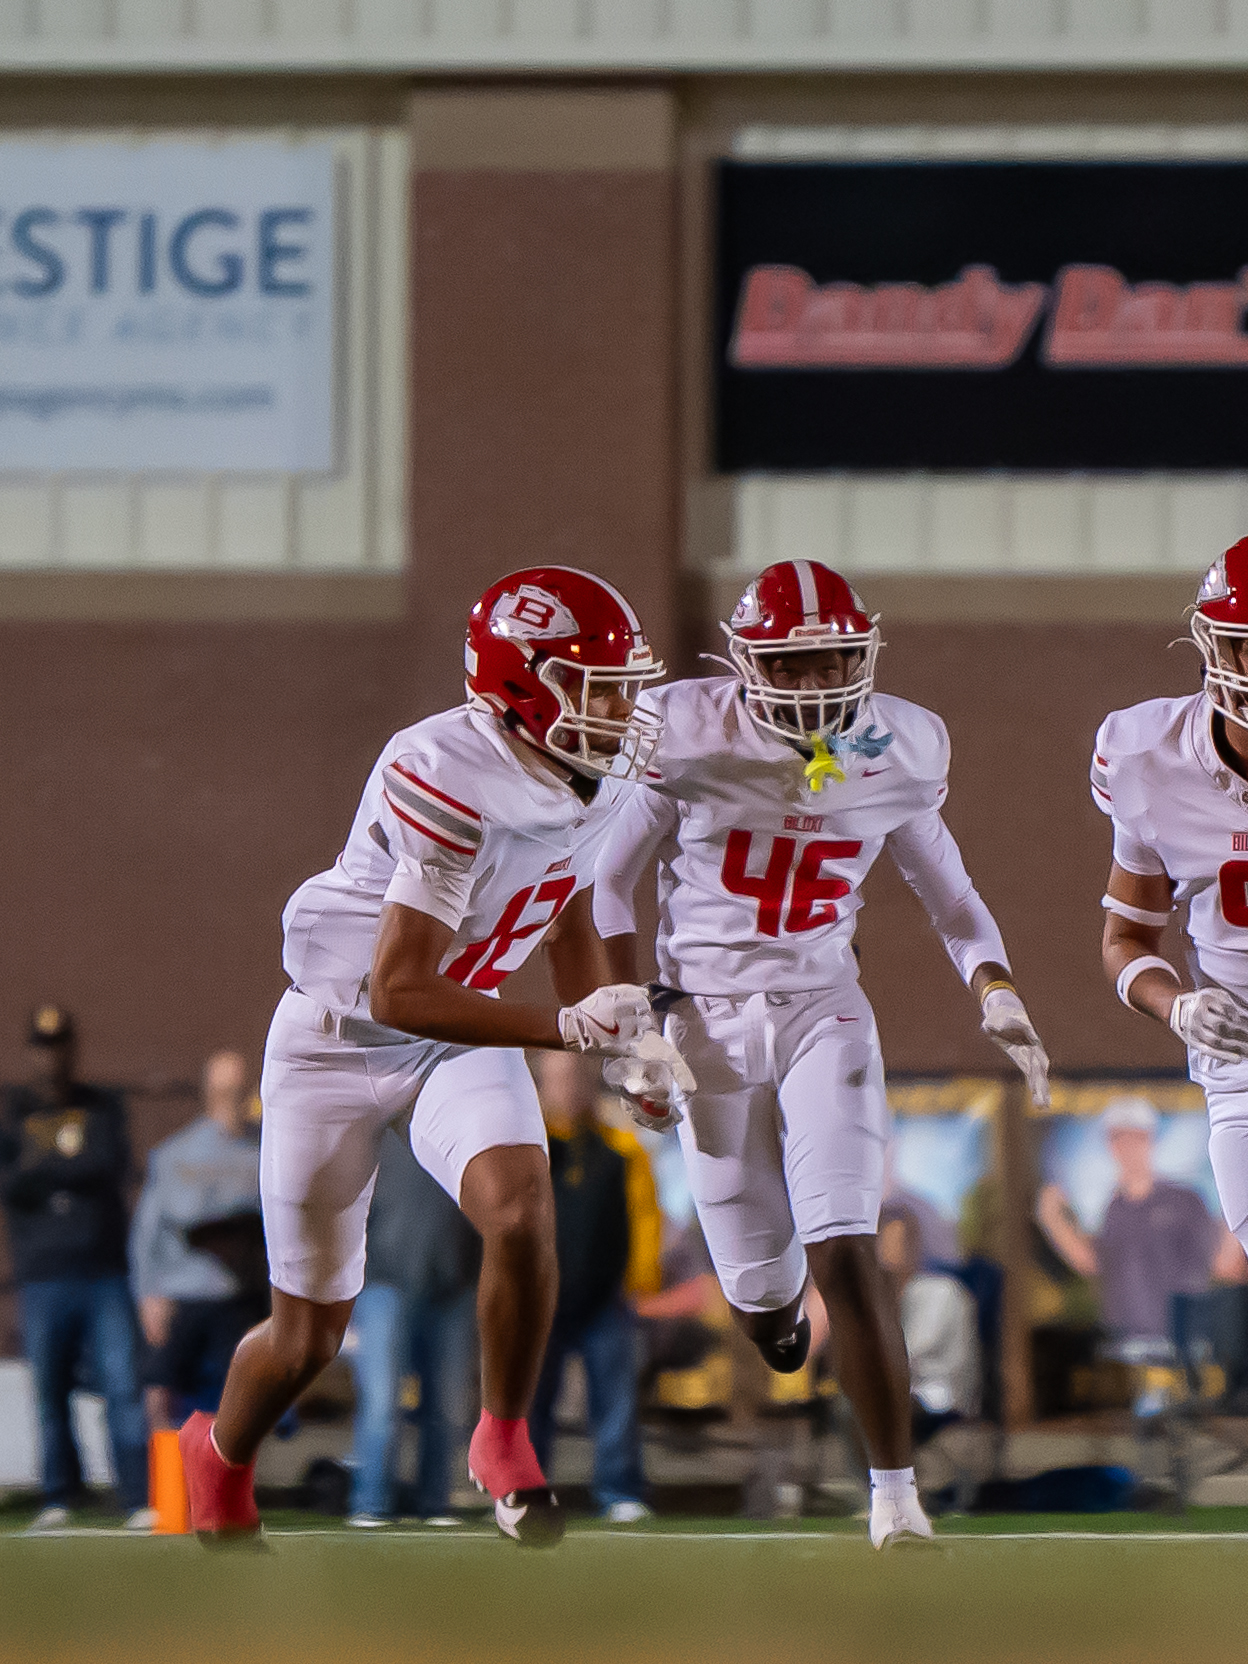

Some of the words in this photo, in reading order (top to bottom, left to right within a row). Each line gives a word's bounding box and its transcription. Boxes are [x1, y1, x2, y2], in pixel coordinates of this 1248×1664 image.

[0, 207, 315, 298] STIGE
[728, 262, 1046, 370] Dandy
[509, 595, 557, 630] B
[721, 828, 864, 938] 46
